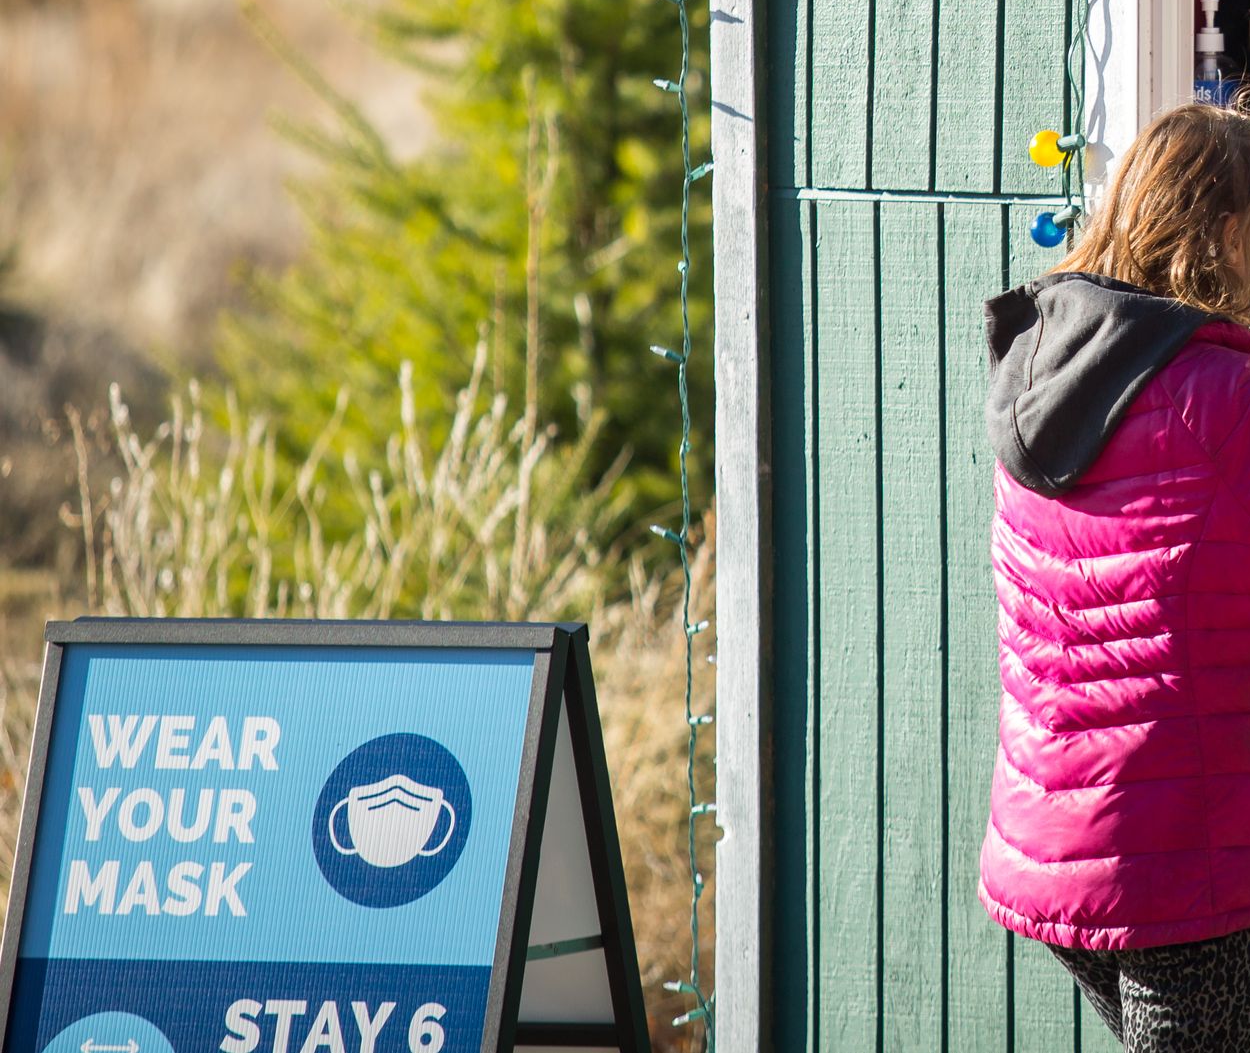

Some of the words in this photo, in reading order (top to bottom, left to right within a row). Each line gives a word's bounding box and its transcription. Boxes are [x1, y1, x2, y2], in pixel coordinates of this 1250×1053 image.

[1193, 86, 1212, 101] ds
[88, 714, 281, 771] WEAR
[77, 787, 257, 844] YOUR
[63, 859, 254, 917] MASK
[219, 998, 397, 1053] STAY
[407, 1001, 448, 1053] 6
